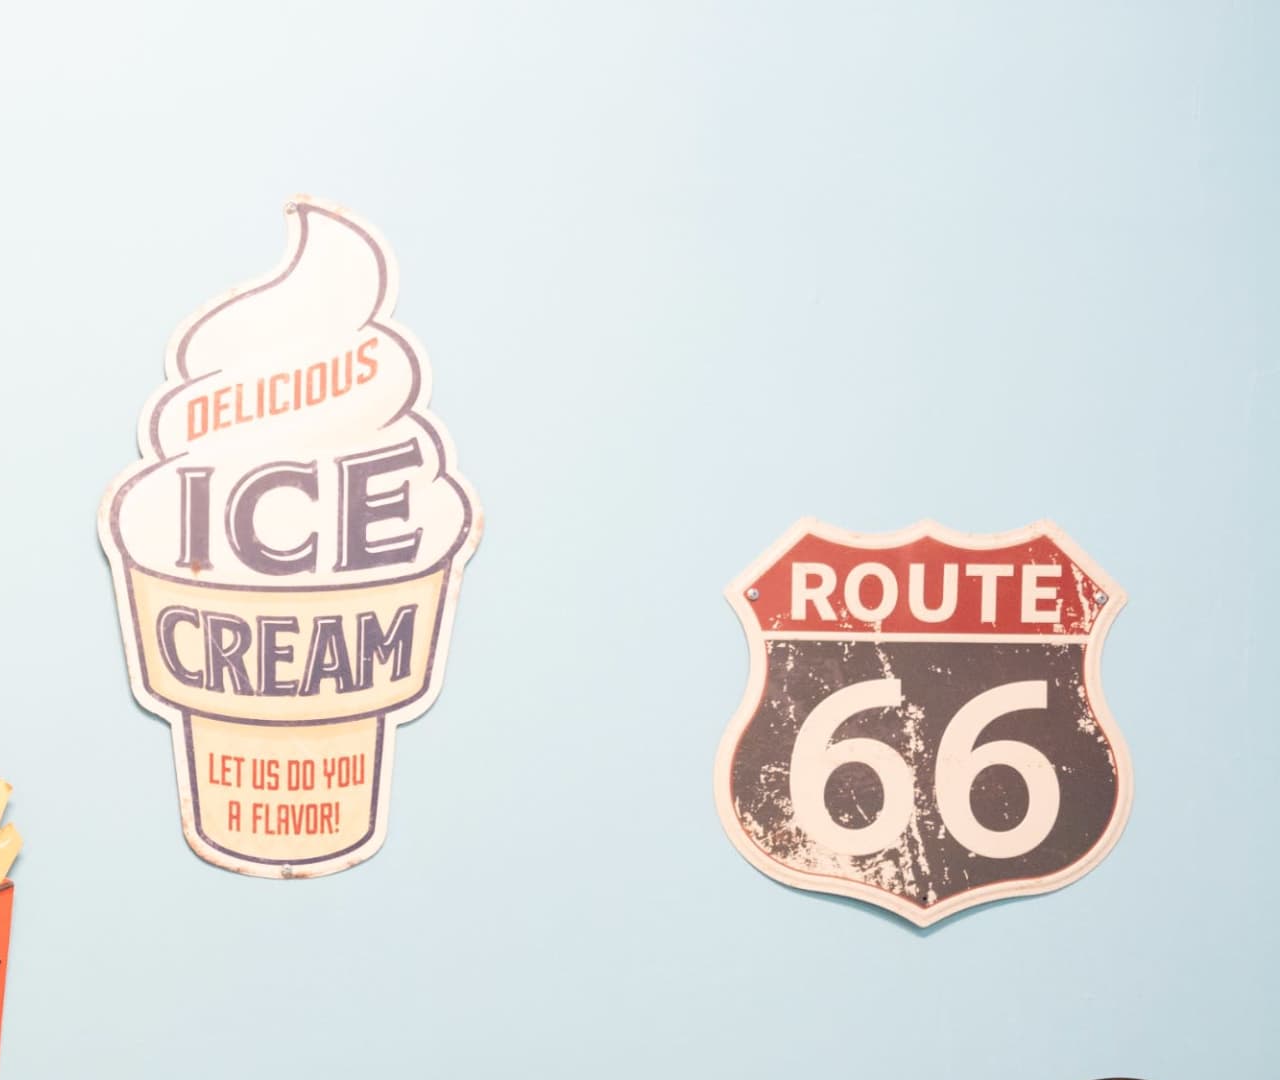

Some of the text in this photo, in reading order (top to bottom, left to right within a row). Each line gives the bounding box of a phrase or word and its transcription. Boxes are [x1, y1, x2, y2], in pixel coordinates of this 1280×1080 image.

[186, 337, 379, 443] DELICIOUS
[175, 437, 424, 576] ICE
[790, 562, 1063, 624] ROUTE
[156, 603, 419, 698] CREAM
[209, 752, 365, 791] LET US DO YOU
[789, 678, 1061, 860] 66
[228, 800, 340, 836] A FLAVOR!
